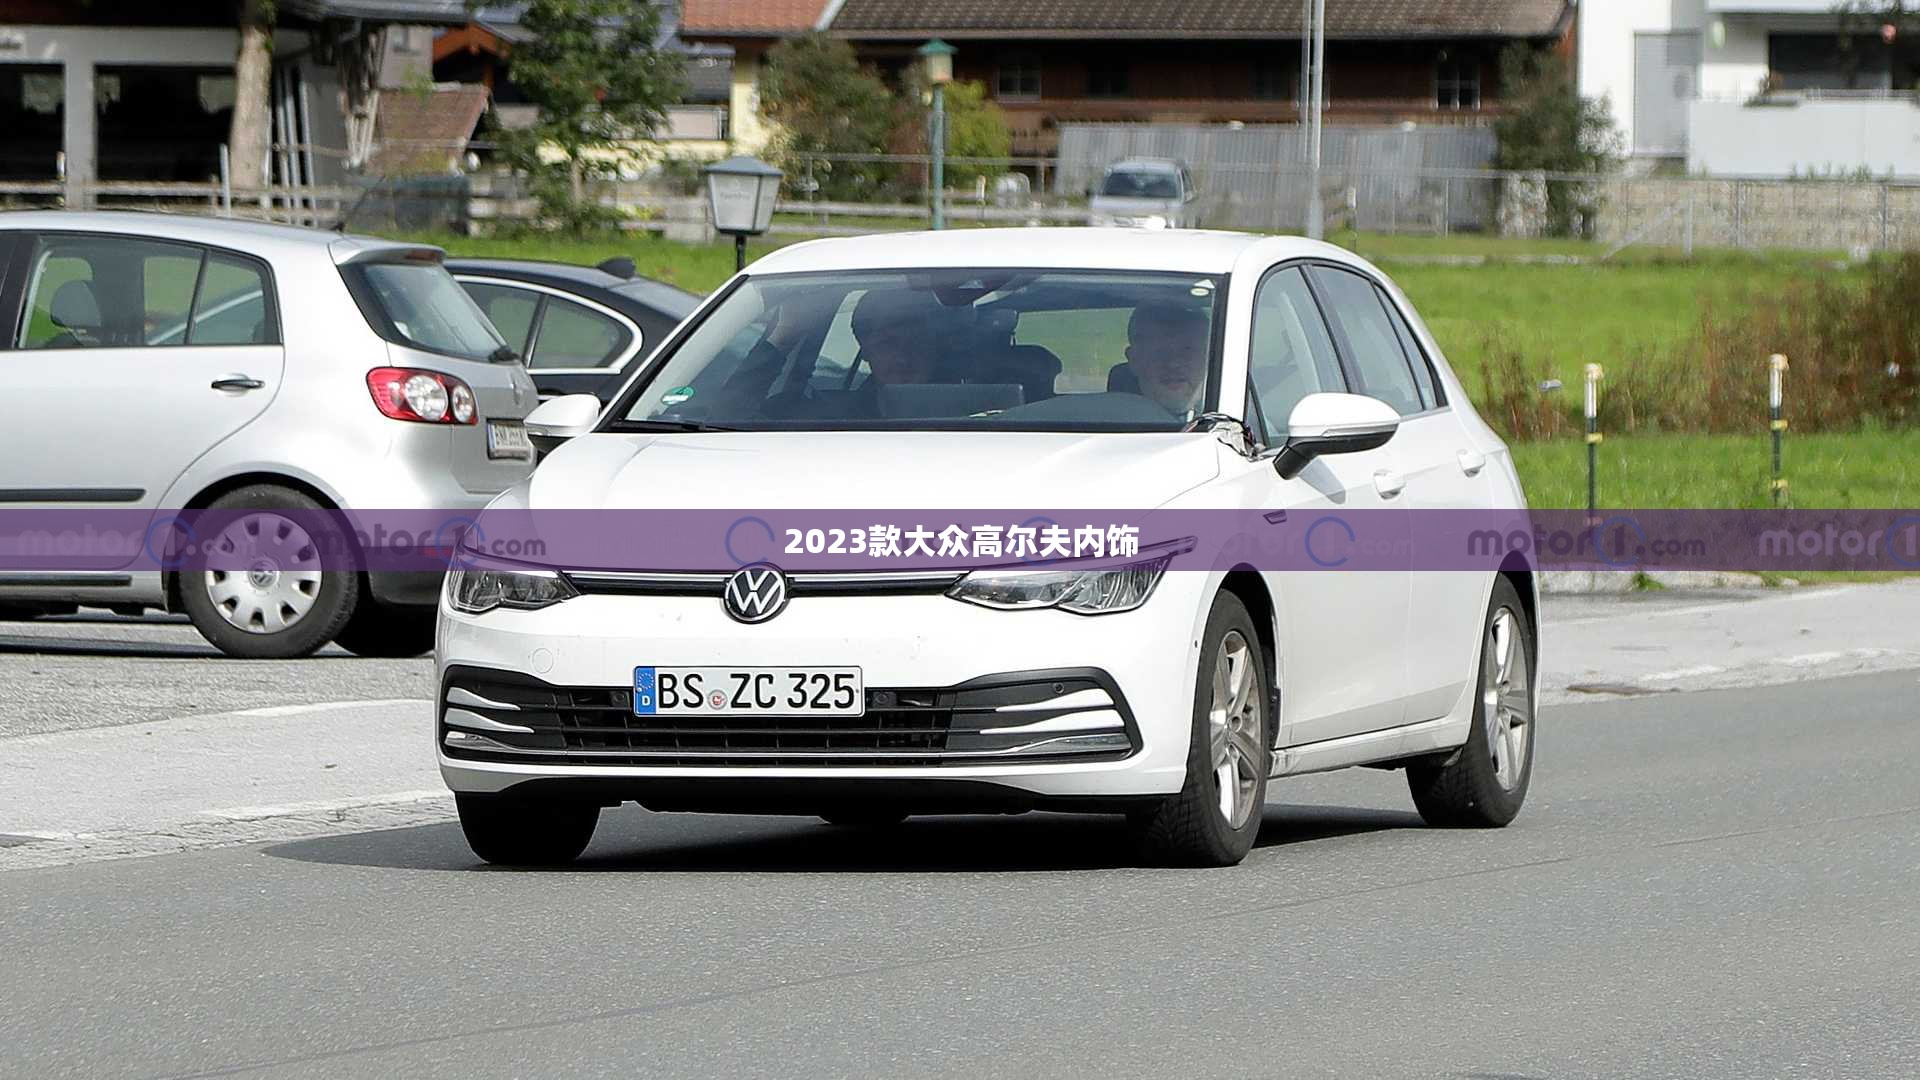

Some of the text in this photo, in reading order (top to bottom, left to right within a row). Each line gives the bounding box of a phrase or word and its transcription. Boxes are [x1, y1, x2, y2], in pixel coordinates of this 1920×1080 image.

[726, 563, 785, 620] VW
[641, 695, 651, 706] D
[658, 673, 855, 709] BS ZC 325
